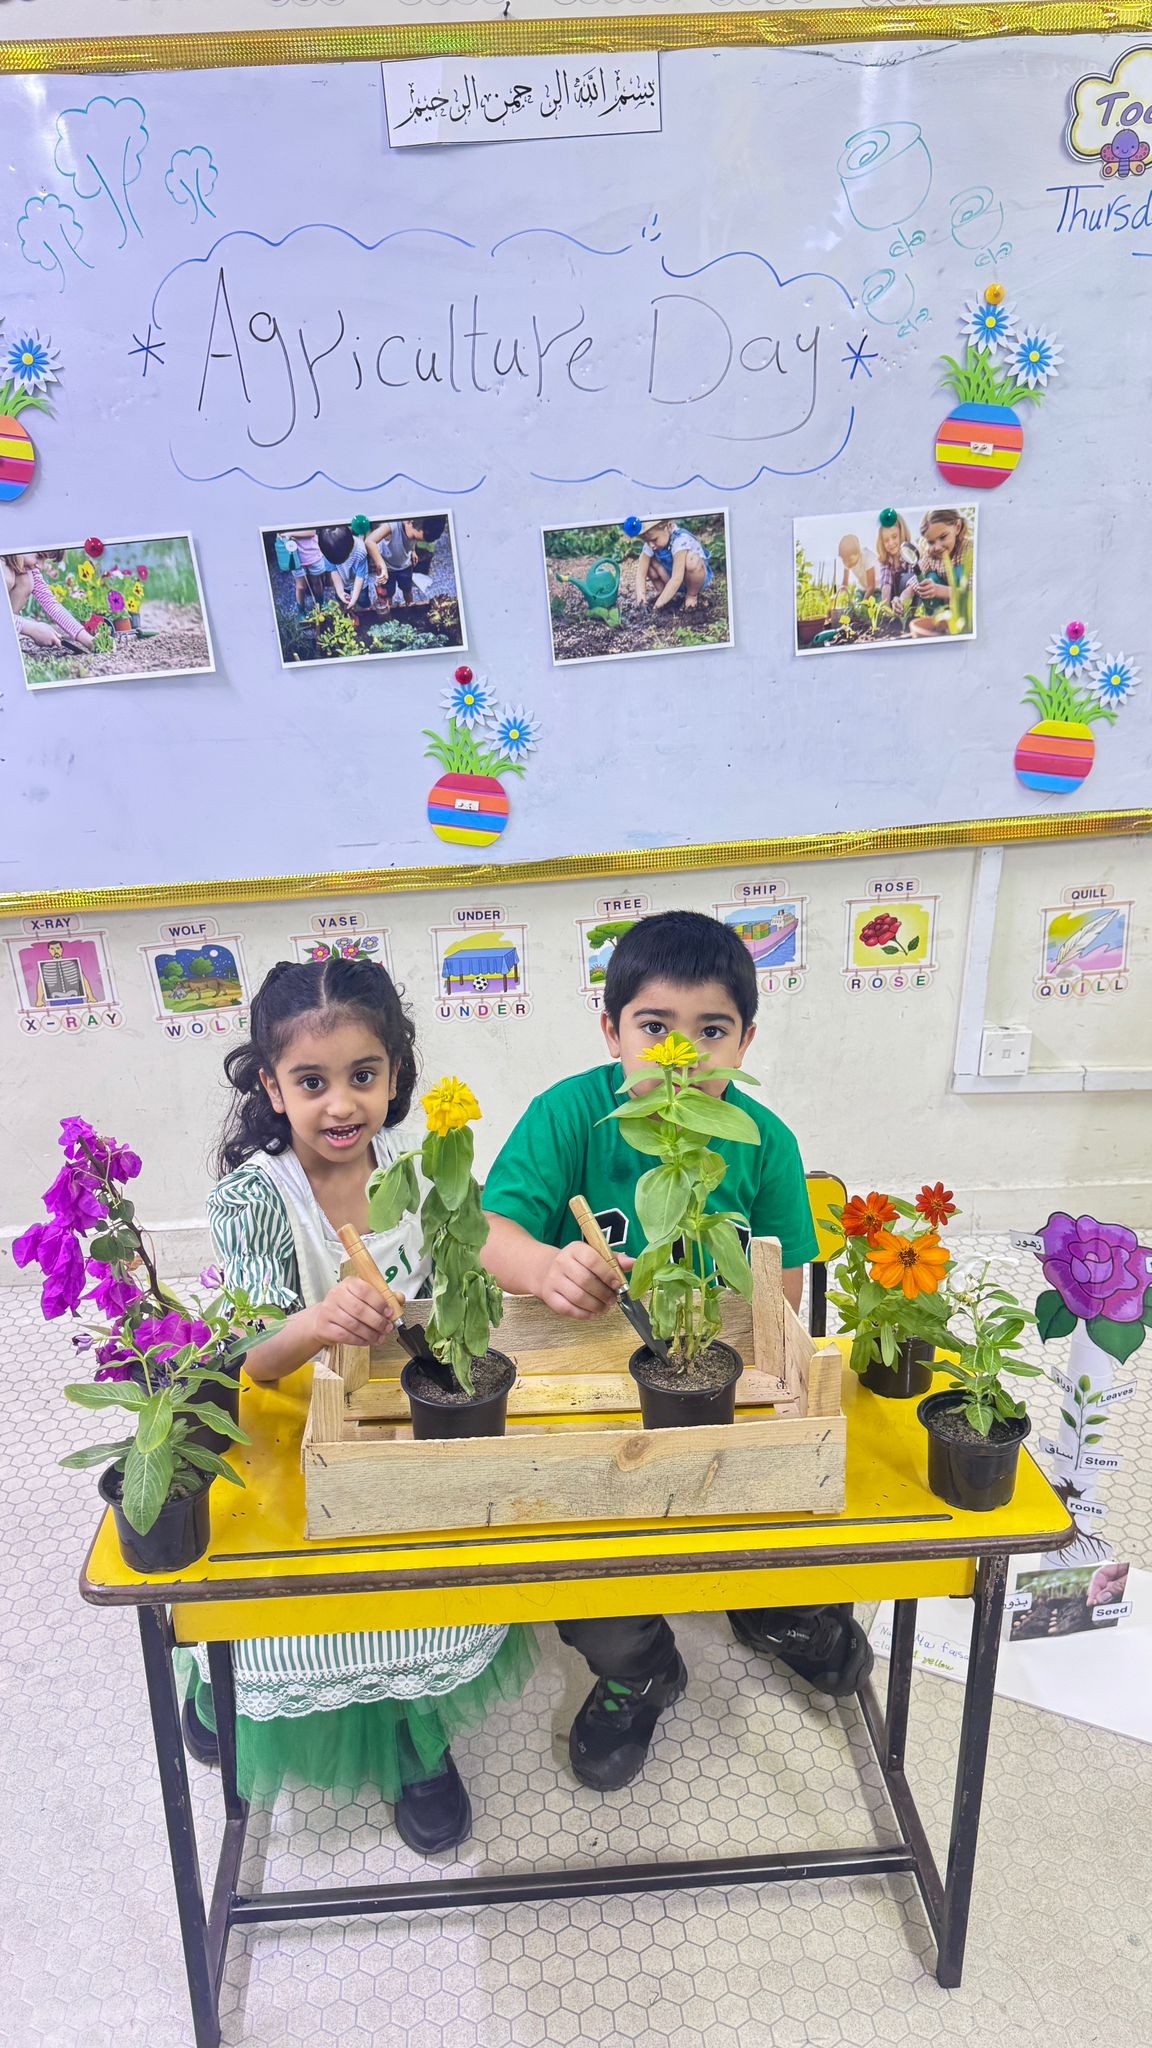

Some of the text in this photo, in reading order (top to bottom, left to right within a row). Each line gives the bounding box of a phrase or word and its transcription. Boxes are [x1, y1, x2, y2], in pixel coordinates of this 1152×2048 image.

[198, 267, 820, 447] Agriculture Day
[742, 884, 777, 896] SHIP
[874, 881, 914, 893] ROSE
[1071, 888, 1108, 900] QUILL
[603, 898, 642, 912] TREE
[318, 915, 358, 928] VASE
[457, 910, 501, 921] UNDER
[31, 917, 71, 930] X-RAY
[169, 924, 207, 937] WOLF
[851, 975, 926, 990] ROSE
[1040, 978, 1124, 997] QUILL
[440, 1003, 526, 1018] UNDER
[24, 1013, 117, 1032] X-RAY
[166, 1017, 248, 1038] WOLF
[1014, 1237, 1042, 1251] زهور
[1100, 1387, 1134, 1402] Leaves
[1044, 1443, 1074, 1460] ساق
[1085, 1456, 1119, 1468] Stem
[1069, 1501, 1103, 1515] roots
[1096, 1605, 1128, 1617] Seed
